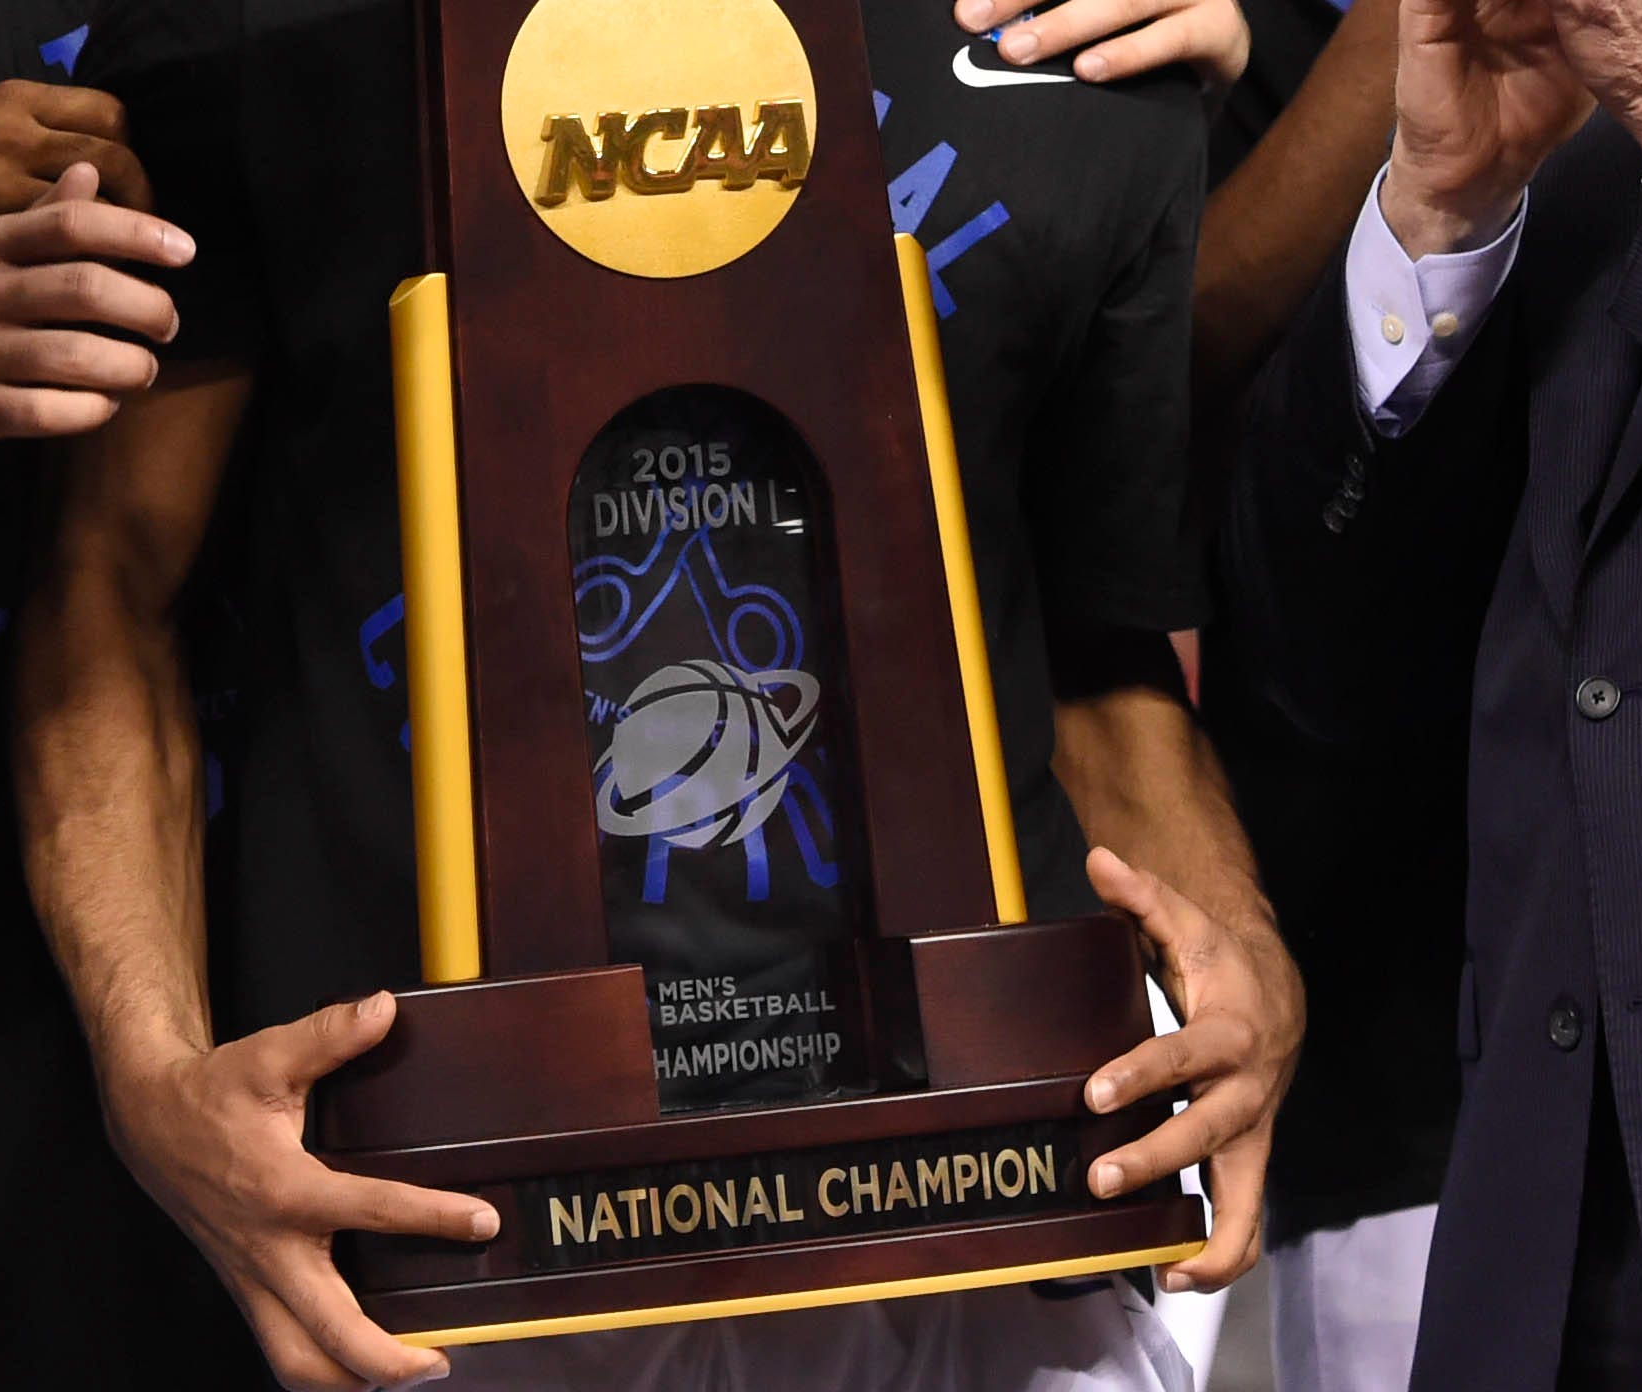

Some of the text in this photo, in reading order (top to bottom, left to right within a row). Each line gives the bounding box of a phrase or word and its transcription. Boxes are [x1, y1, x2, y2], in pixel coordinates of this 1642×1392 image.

[533, 96, 810, 208] NCAA
[631, 441, 732, 483] 2015
[592, 484, 758, 538] DIVISION
[658, 976, 737, 1003] MEN'S
[660, 990, 836, 1026] BASKETBALL
[652, 1032, 841, 1080] HAMPIONSHIP
[549, 1144, 1057, 1246] NATIONAL CHAMPION
